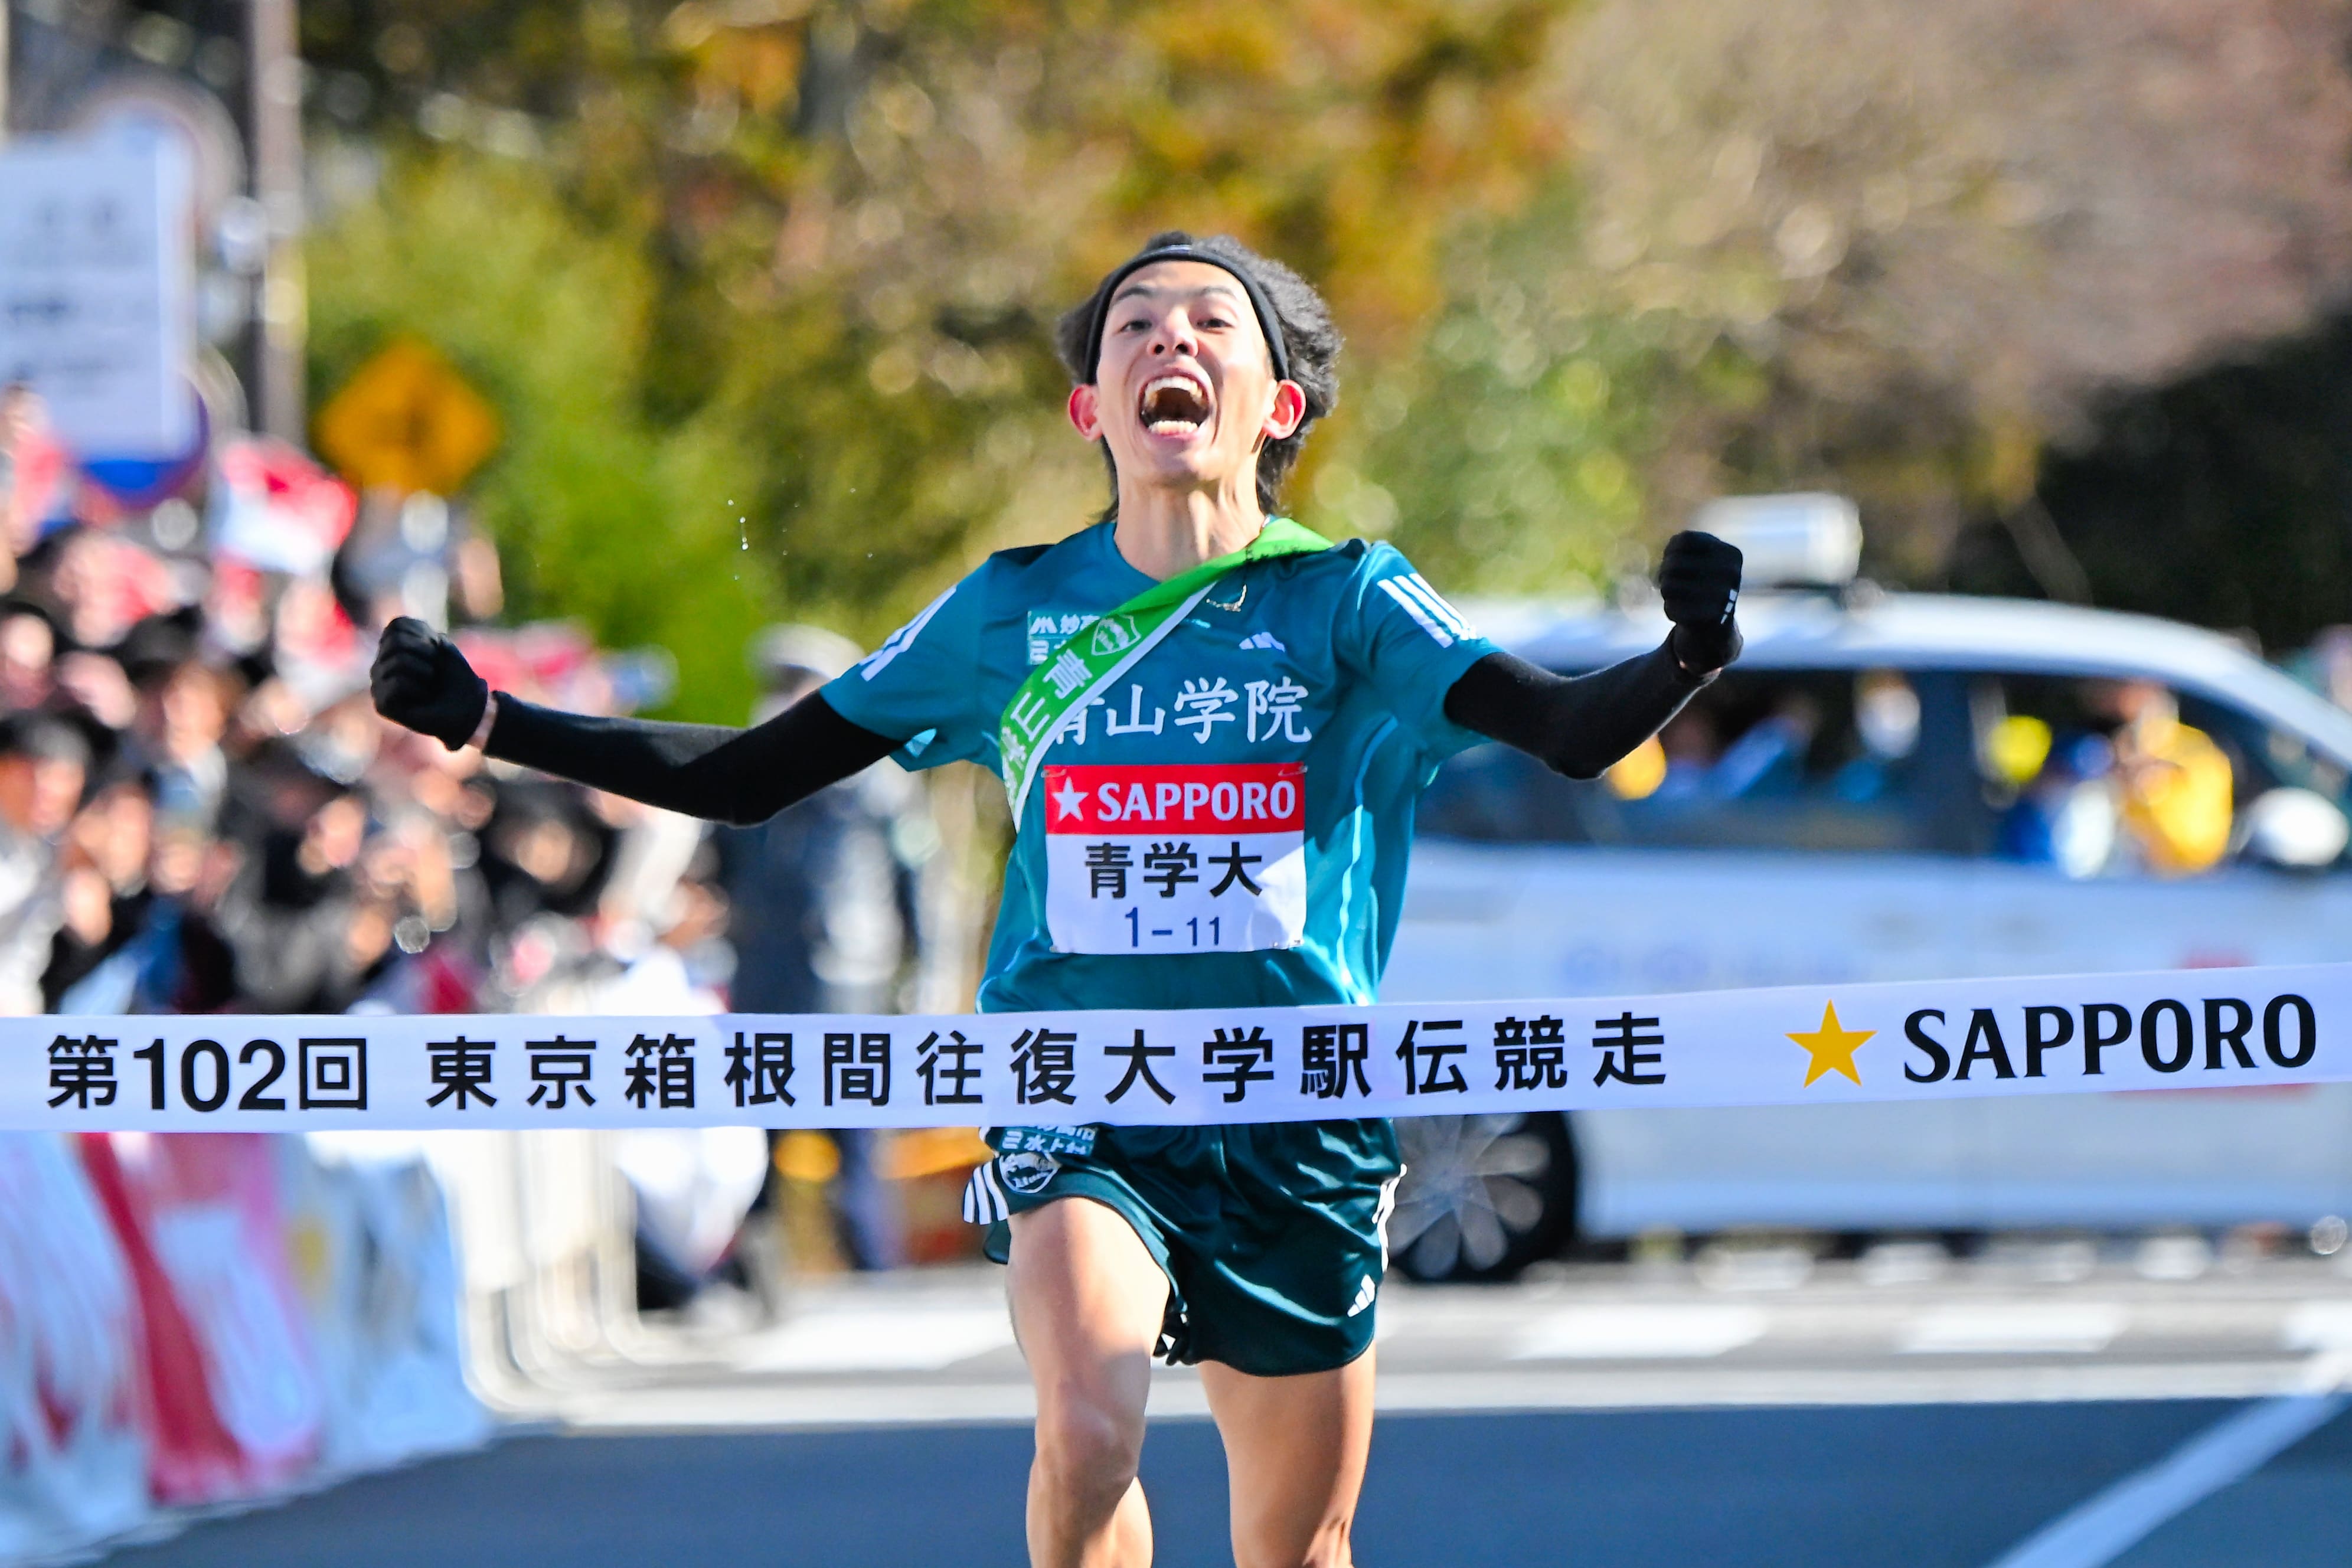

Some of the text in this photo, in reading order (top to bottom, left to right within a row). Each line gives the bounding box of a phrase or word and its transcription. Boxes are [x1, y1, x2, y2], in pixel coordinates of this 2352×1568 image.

[1097, 780, 1296, 822] SAPPORO
[1085, 842, 1262, 899] 青学大
[47, 1011, 1667, 1113] 第102回 東京箱根間往復大学駅伝競走
[1904, 994, 2317, 1083] SAPPORO
